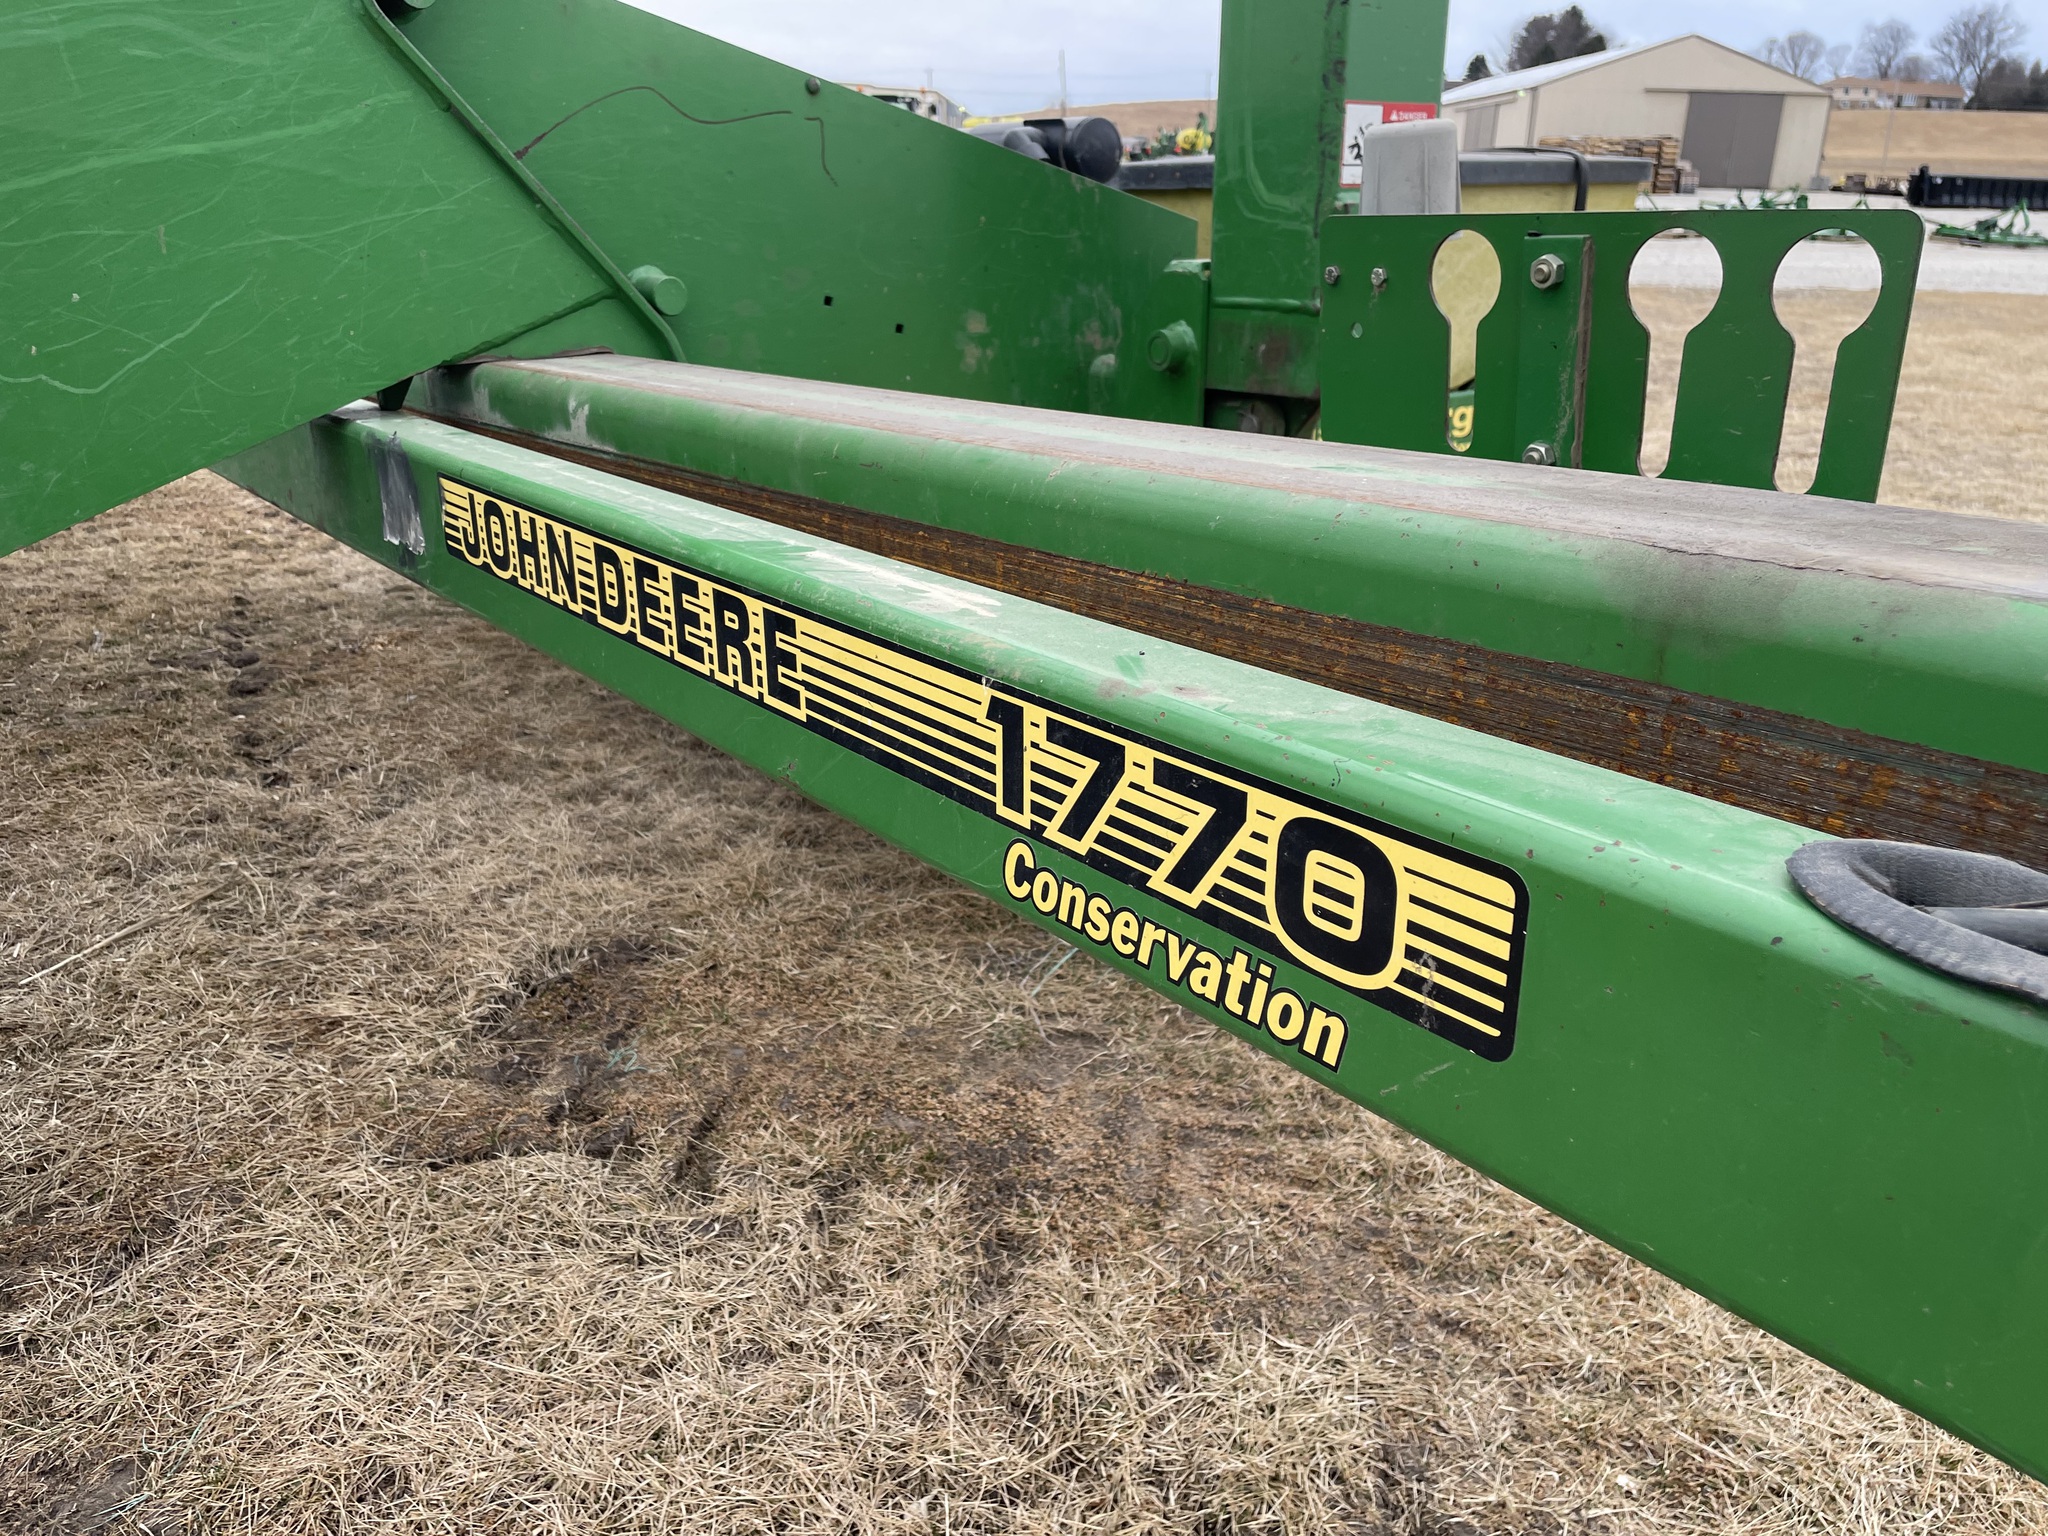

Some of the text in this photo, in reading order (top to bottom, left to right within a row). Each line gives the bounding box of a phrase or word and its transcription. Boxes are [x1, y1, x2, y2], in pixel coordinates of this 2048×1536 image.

[460, 491, 1403, 988] JOHN DEERE 1770
[1003, 838, 1348, 1072] Conservation
